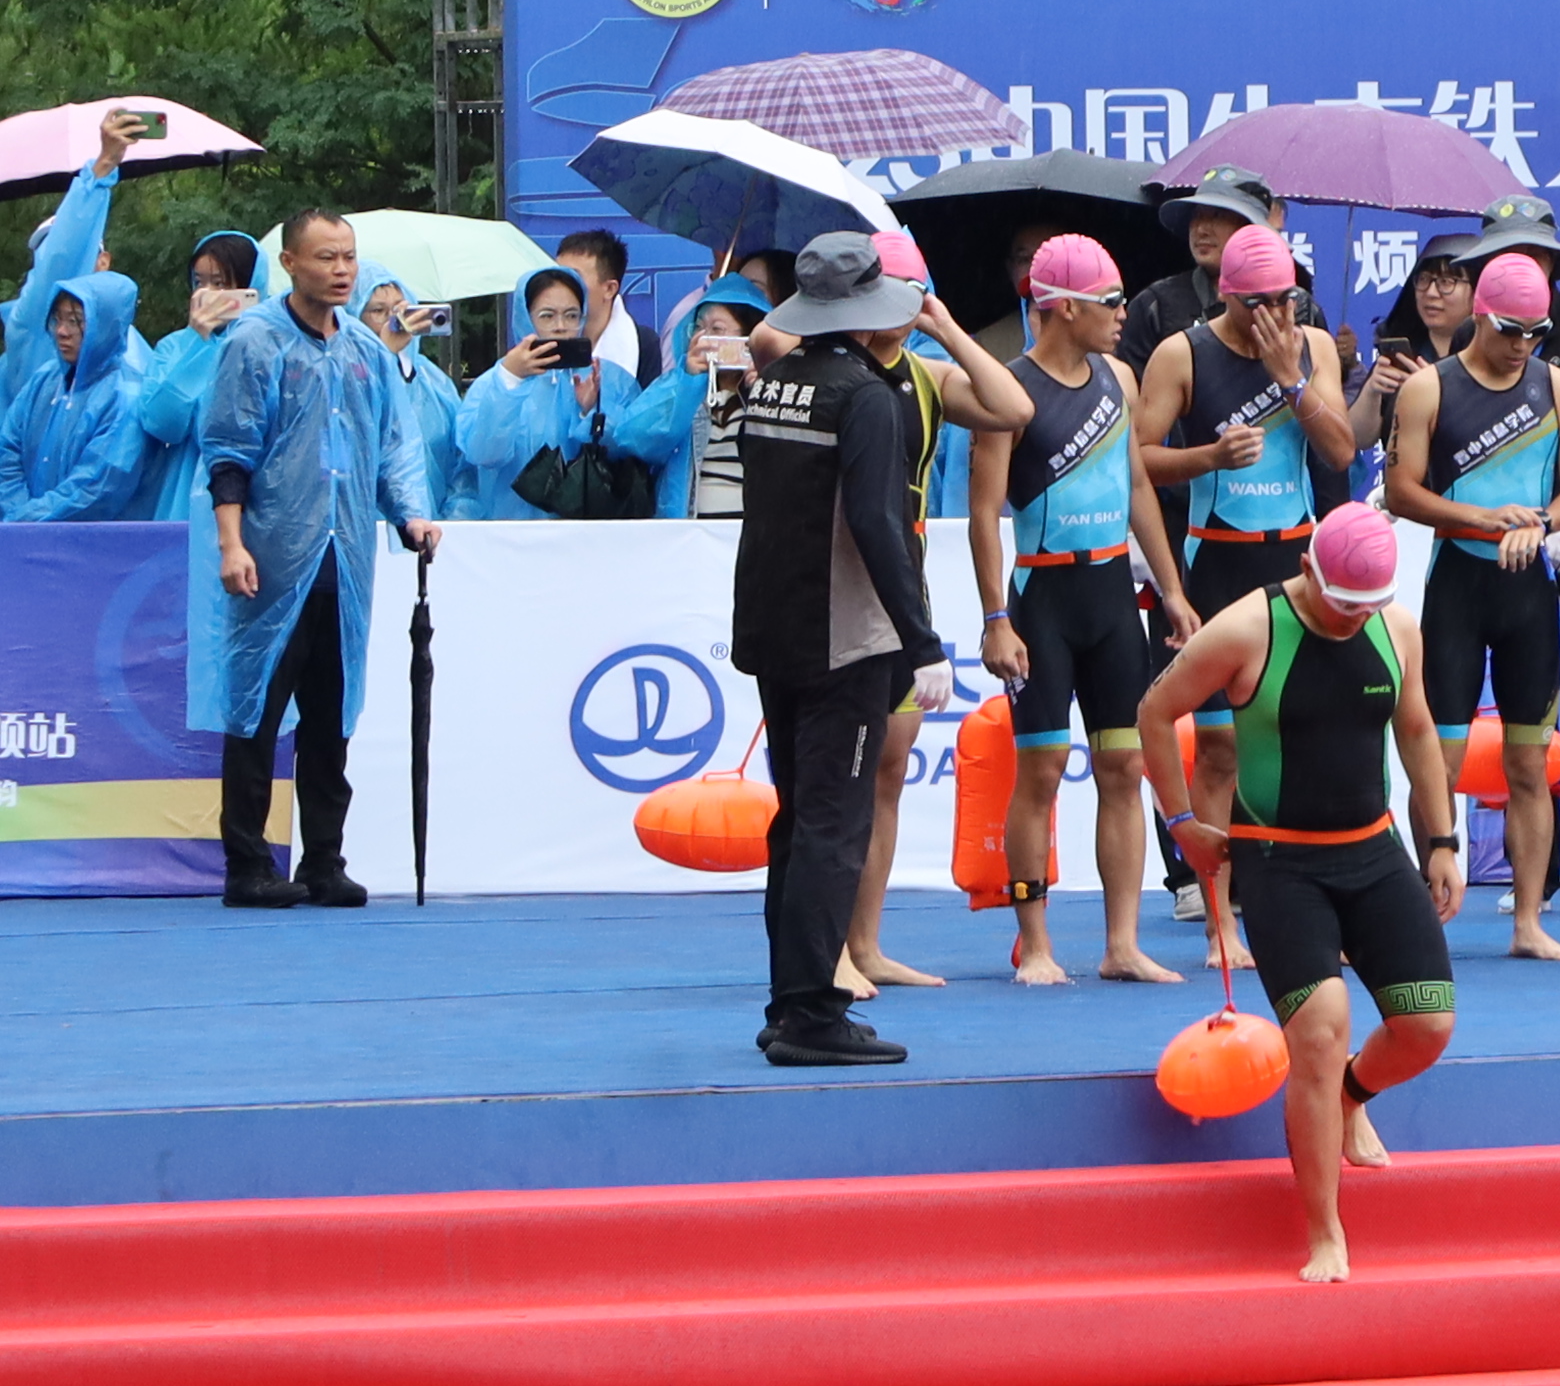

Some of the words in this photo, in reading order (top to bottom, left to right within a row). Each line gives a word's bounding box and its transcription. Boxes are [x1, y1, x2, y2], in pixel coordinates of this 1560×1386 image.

[748, 377, 816, 407] 技术官员
[779, 406, 812, 424] Official
[1453, 403, 1535, 466] 晋中信息学院
[1228, 481, 1283, 496] WANG
[1058, 513, 1091, 526] YAN
